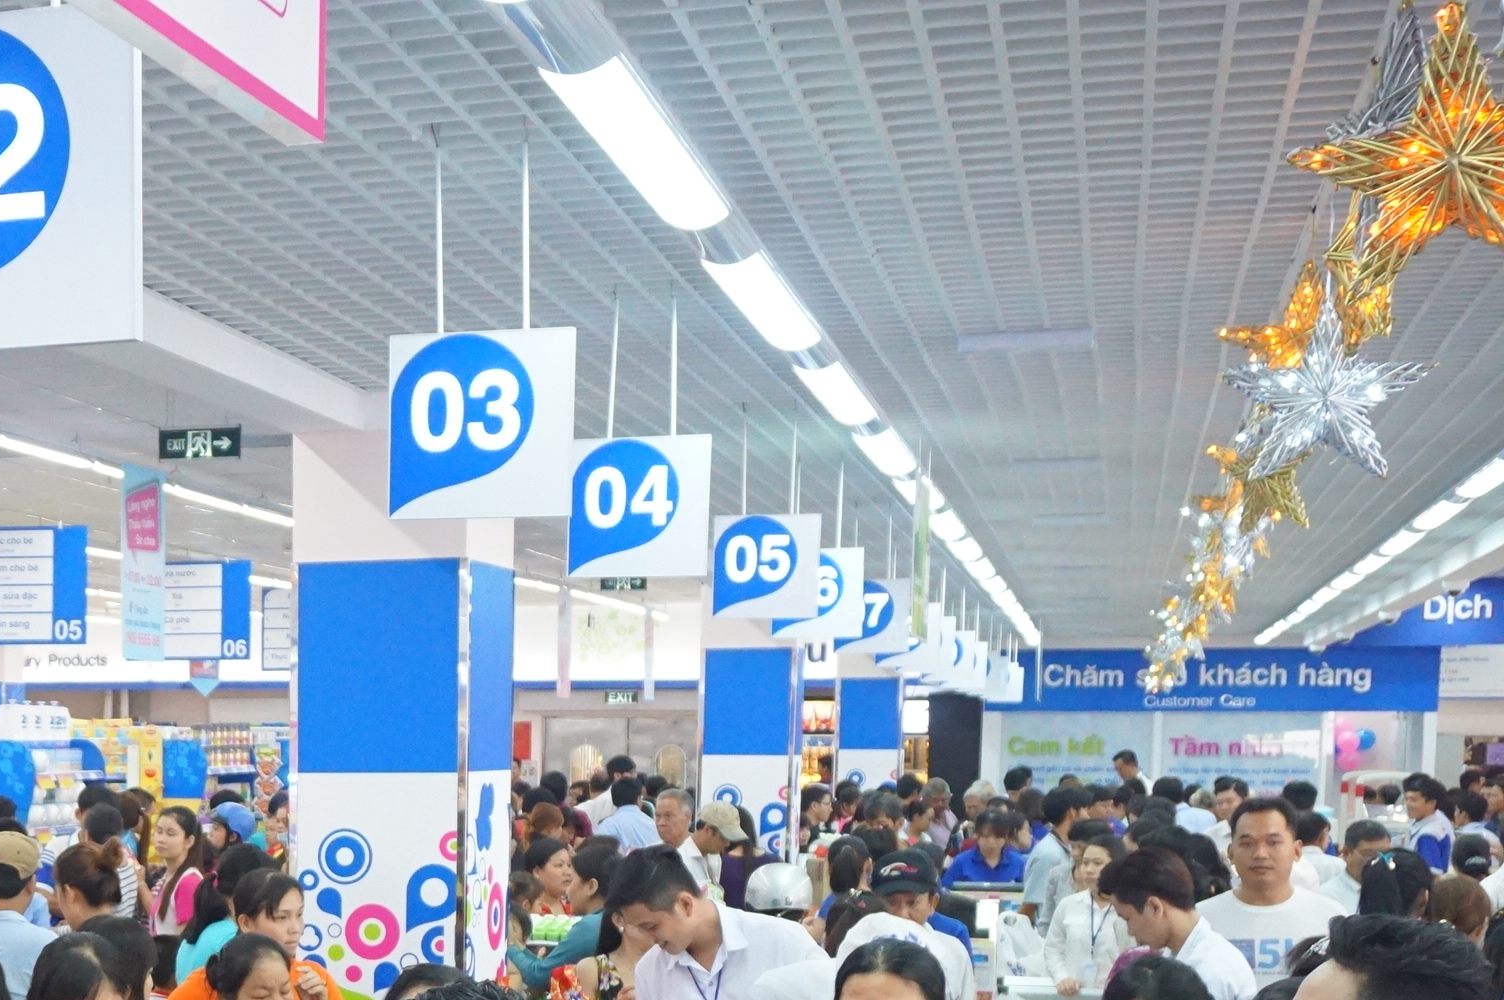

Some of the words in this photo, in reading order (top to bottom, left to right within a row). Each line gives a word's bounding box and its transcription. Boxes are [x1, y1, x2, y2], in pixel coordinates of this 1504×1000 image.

[410, 368, 523, 453] 03
[167, 439, 186, 451] EXIT
[584, 465, 673, 529] 04
[6, 536, 22, 545] cho
[9, 564, 26, 573] cho
[724, 534, 791, 582] 05
[817, 565, 839, 608] 6
[863, 592, 890, 628] 7
[1423, 593, 1493, 625] Dịch
[9, 619, 30, 630] sáng
[54, 619, 82, 639] 05
[222, 639, 247, 657] 06
[48, 654, 107, 668] Products
[1044, 663, 1124, 688] Chăm
[1199, 661, 1287, 688] khách
[1299, 662, 1373, 693] hàng
[608, 692, 633, 703] EXIT
[1145, 694, 1215, 708] Customer
[1220, 693, 1256, 707] Care
[1007, 735, 1060, 757] Cam
[1068, 733, 1105, 756] kết
[1169, 734, 1220, 758] Tầm
